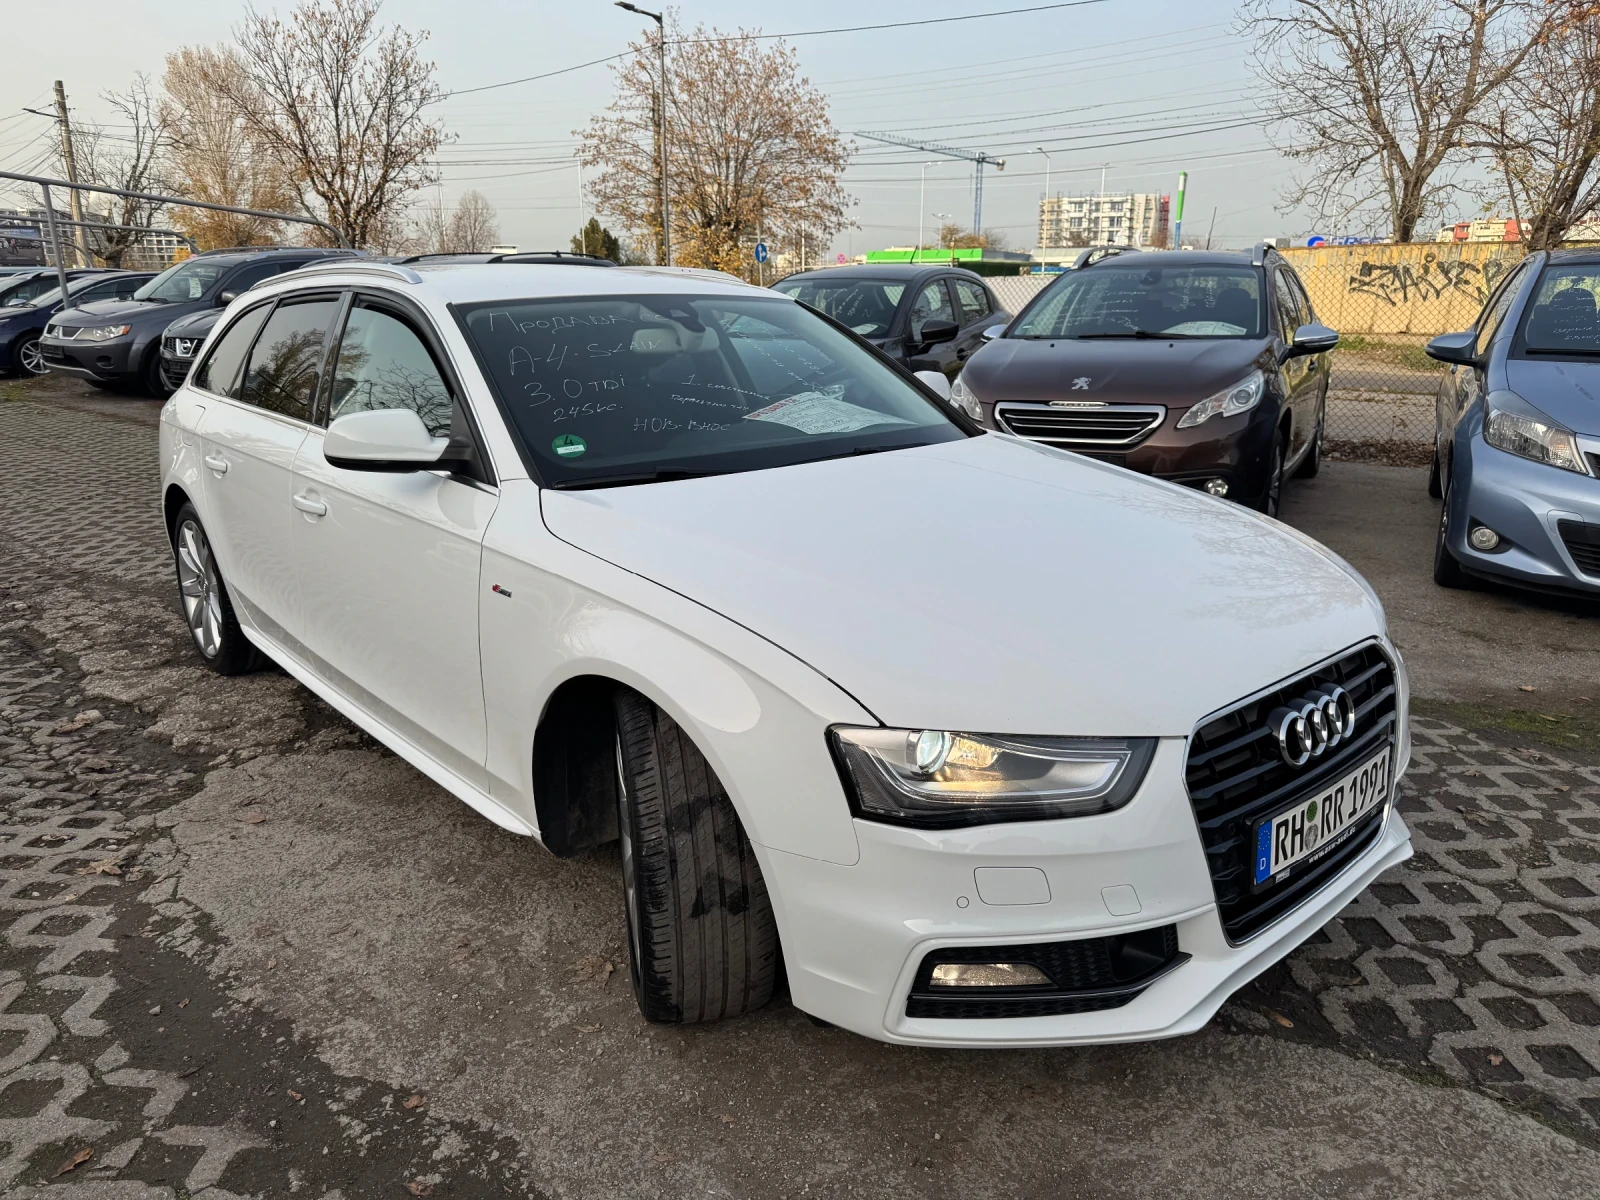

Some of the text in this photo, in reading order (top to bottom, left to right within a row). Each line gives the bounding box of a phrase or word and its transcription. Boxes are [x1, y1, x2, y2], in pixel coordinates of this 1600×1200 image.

[563, 435, 574, 446] 4
[1273, 754, 1387, 867] RH RR 1991
[1259, 857, 1267, 871] D
